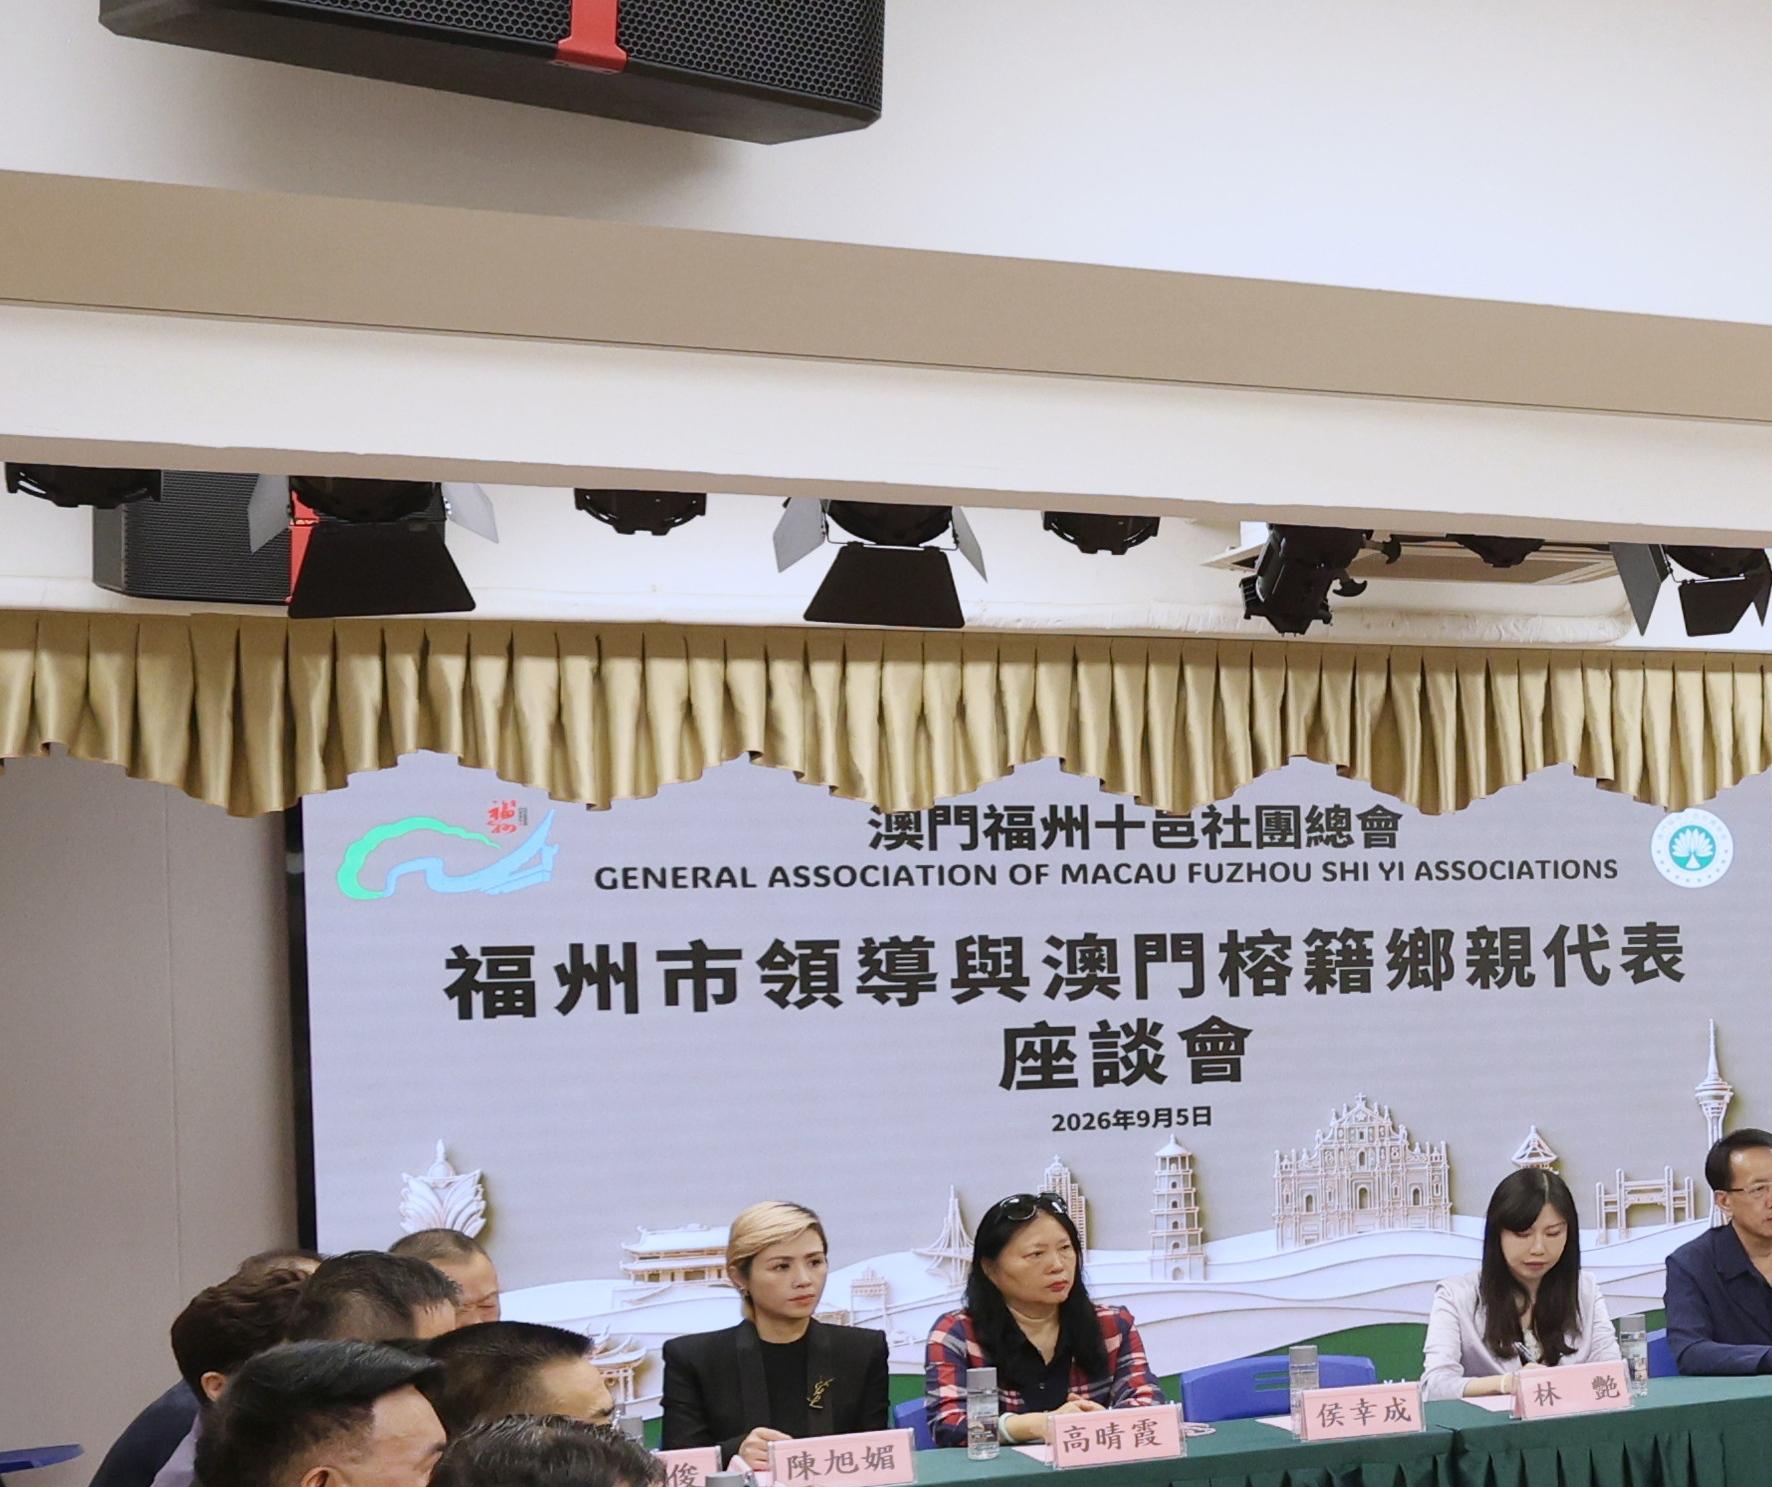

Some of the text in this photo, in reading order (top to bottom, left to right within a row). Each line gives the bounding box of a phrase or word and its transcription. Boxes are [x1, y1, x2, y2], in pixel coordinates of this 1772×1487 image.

[869, 803, 1402, 851] 澳門福州十邑社團總會
[594, 858, 1618, 890] GENERAL ASSOCIATION OF MACAU FUZHOU SHI YI ASSOCIATIONS
[444, 922, 1686, 1020] 福州市領導與澳門榕籍鄉親代表
[1000, 1014, 1252, 1092] 座談會
[1051, 1107, 1213, 1133] 2026年9月5日
[1316, 1397, 1412, 1429] 侯幸成
[1062, 1418, 1163, 1455] 高晴霞
[787, 1443, 896, 1482] 陳旭媚
